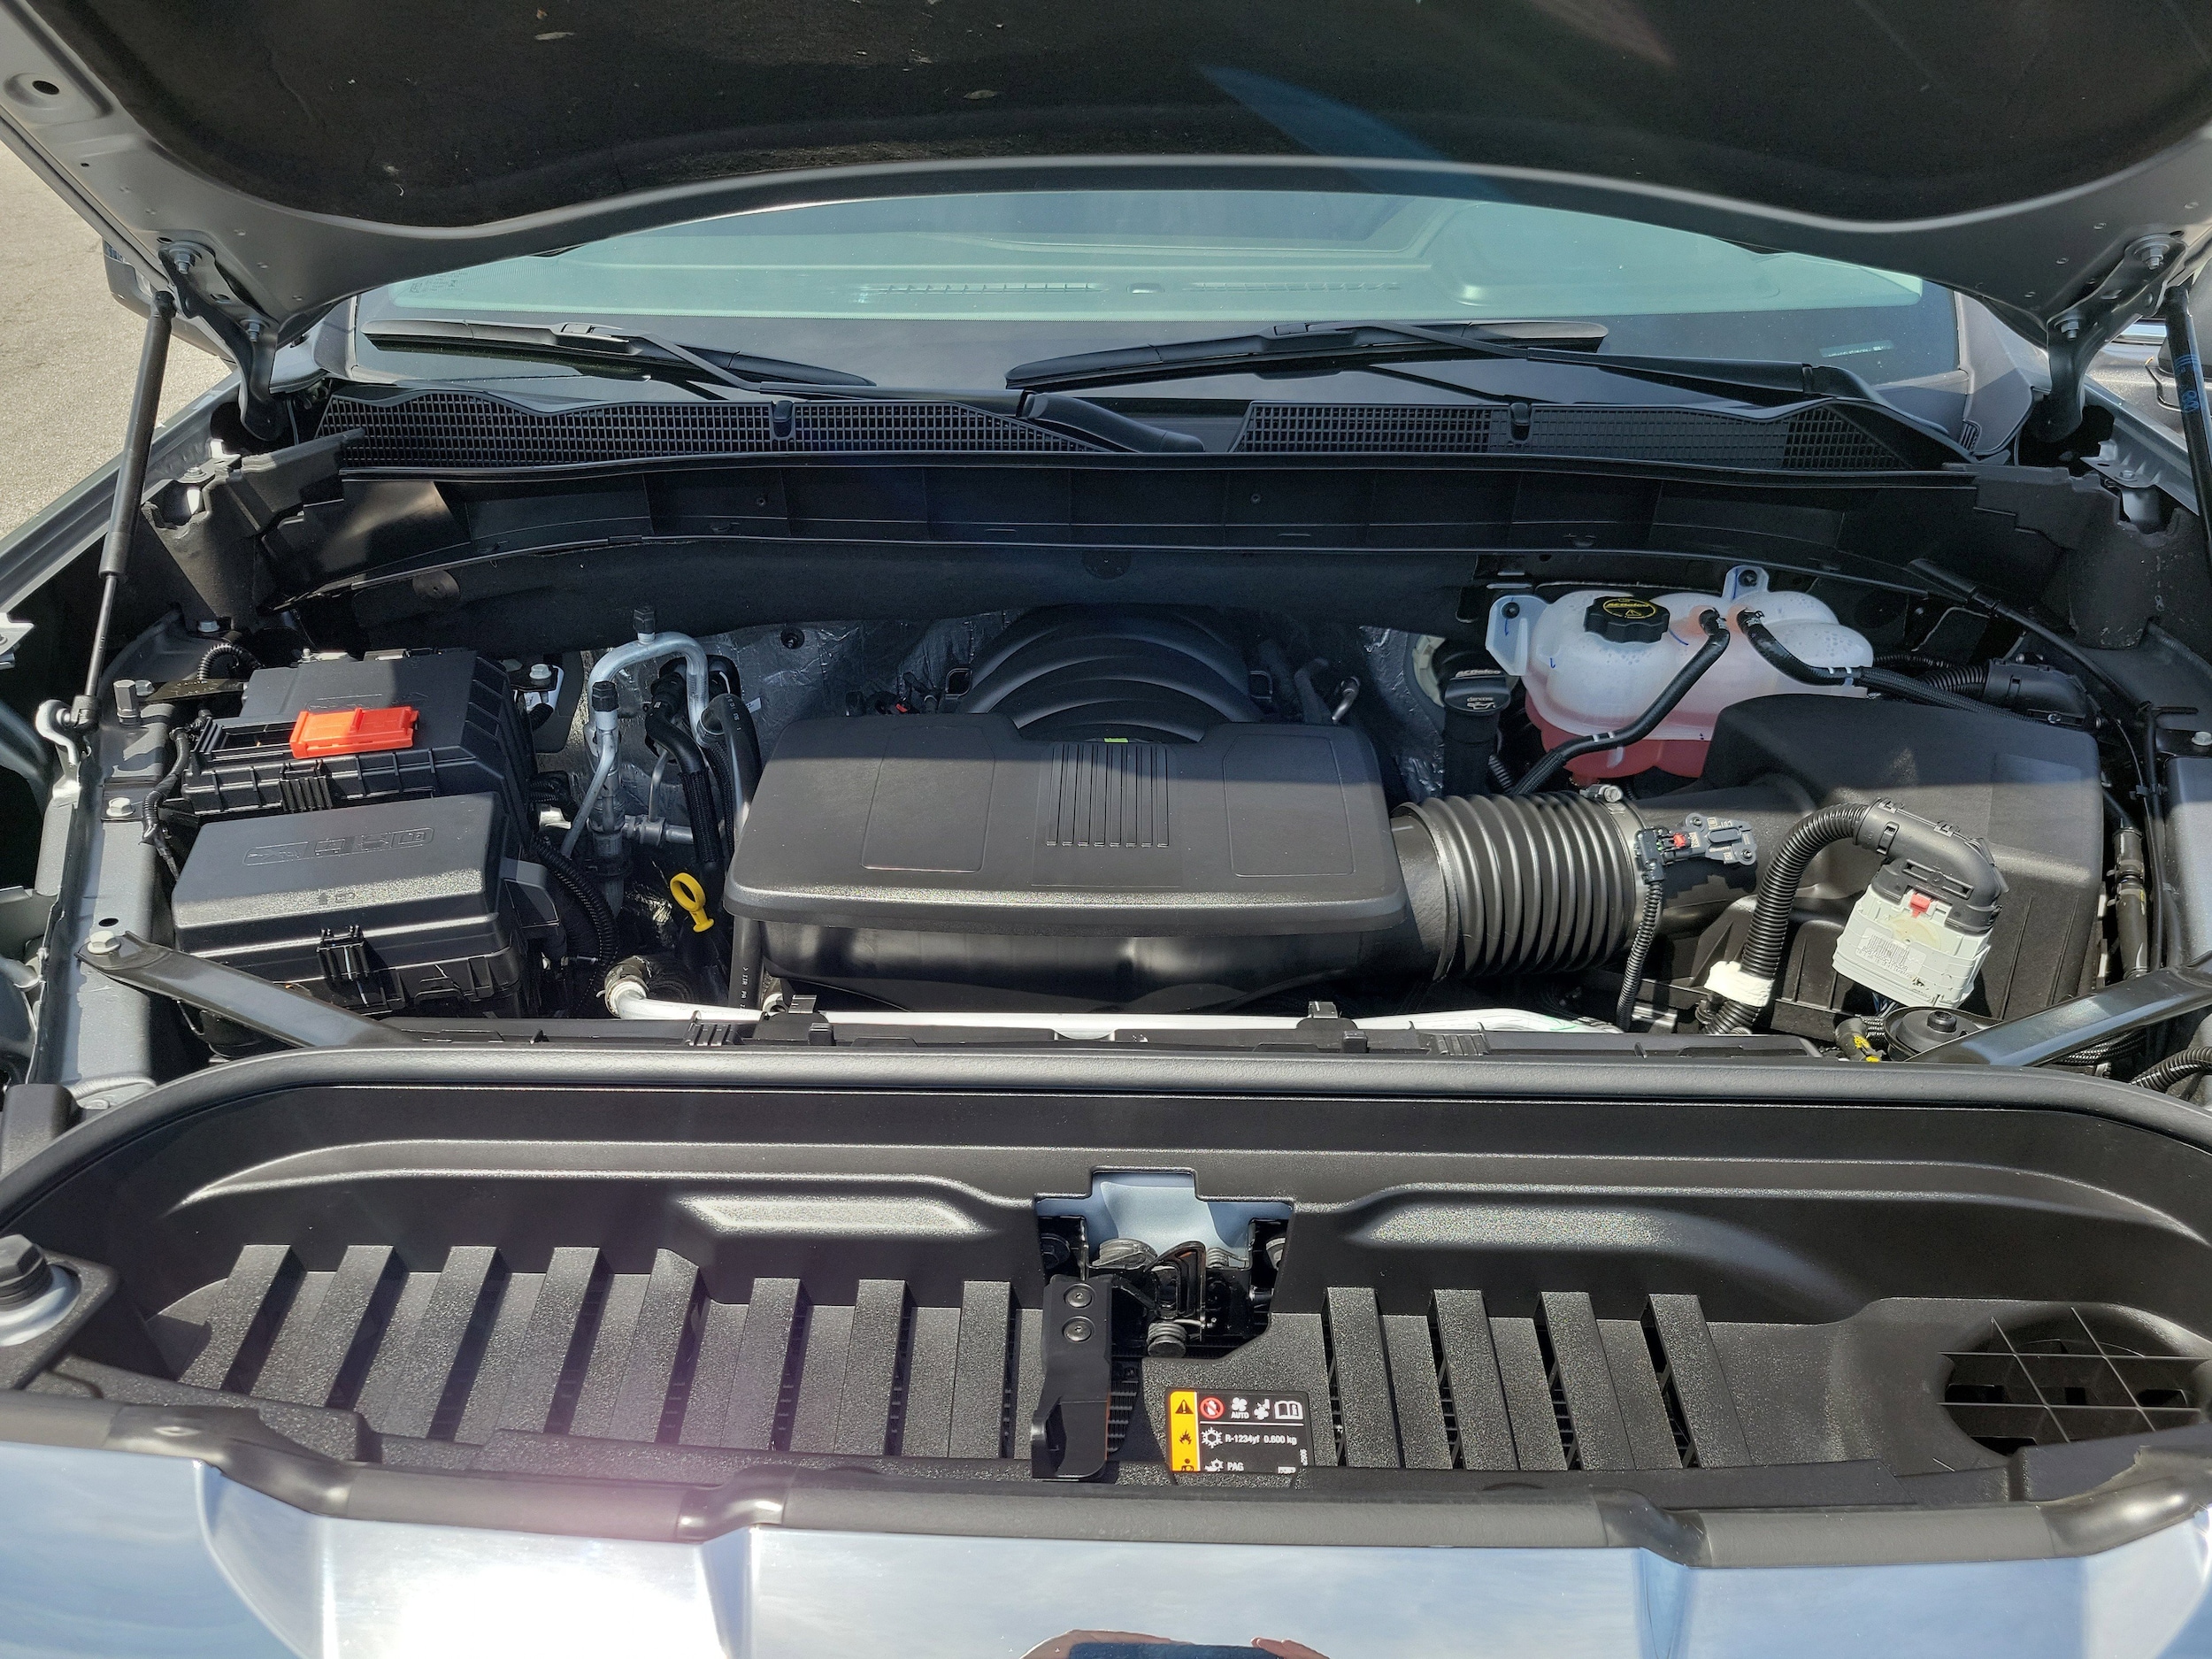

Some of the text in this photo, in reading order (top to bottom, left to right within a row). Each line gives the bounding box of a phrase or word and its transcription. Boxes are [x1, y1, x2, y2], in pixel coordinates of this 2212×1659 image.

[1225, 1433, 1297, 1445] R-1234yf 0.600 kg
[1227, 1462, 1244, 1471] PAG
